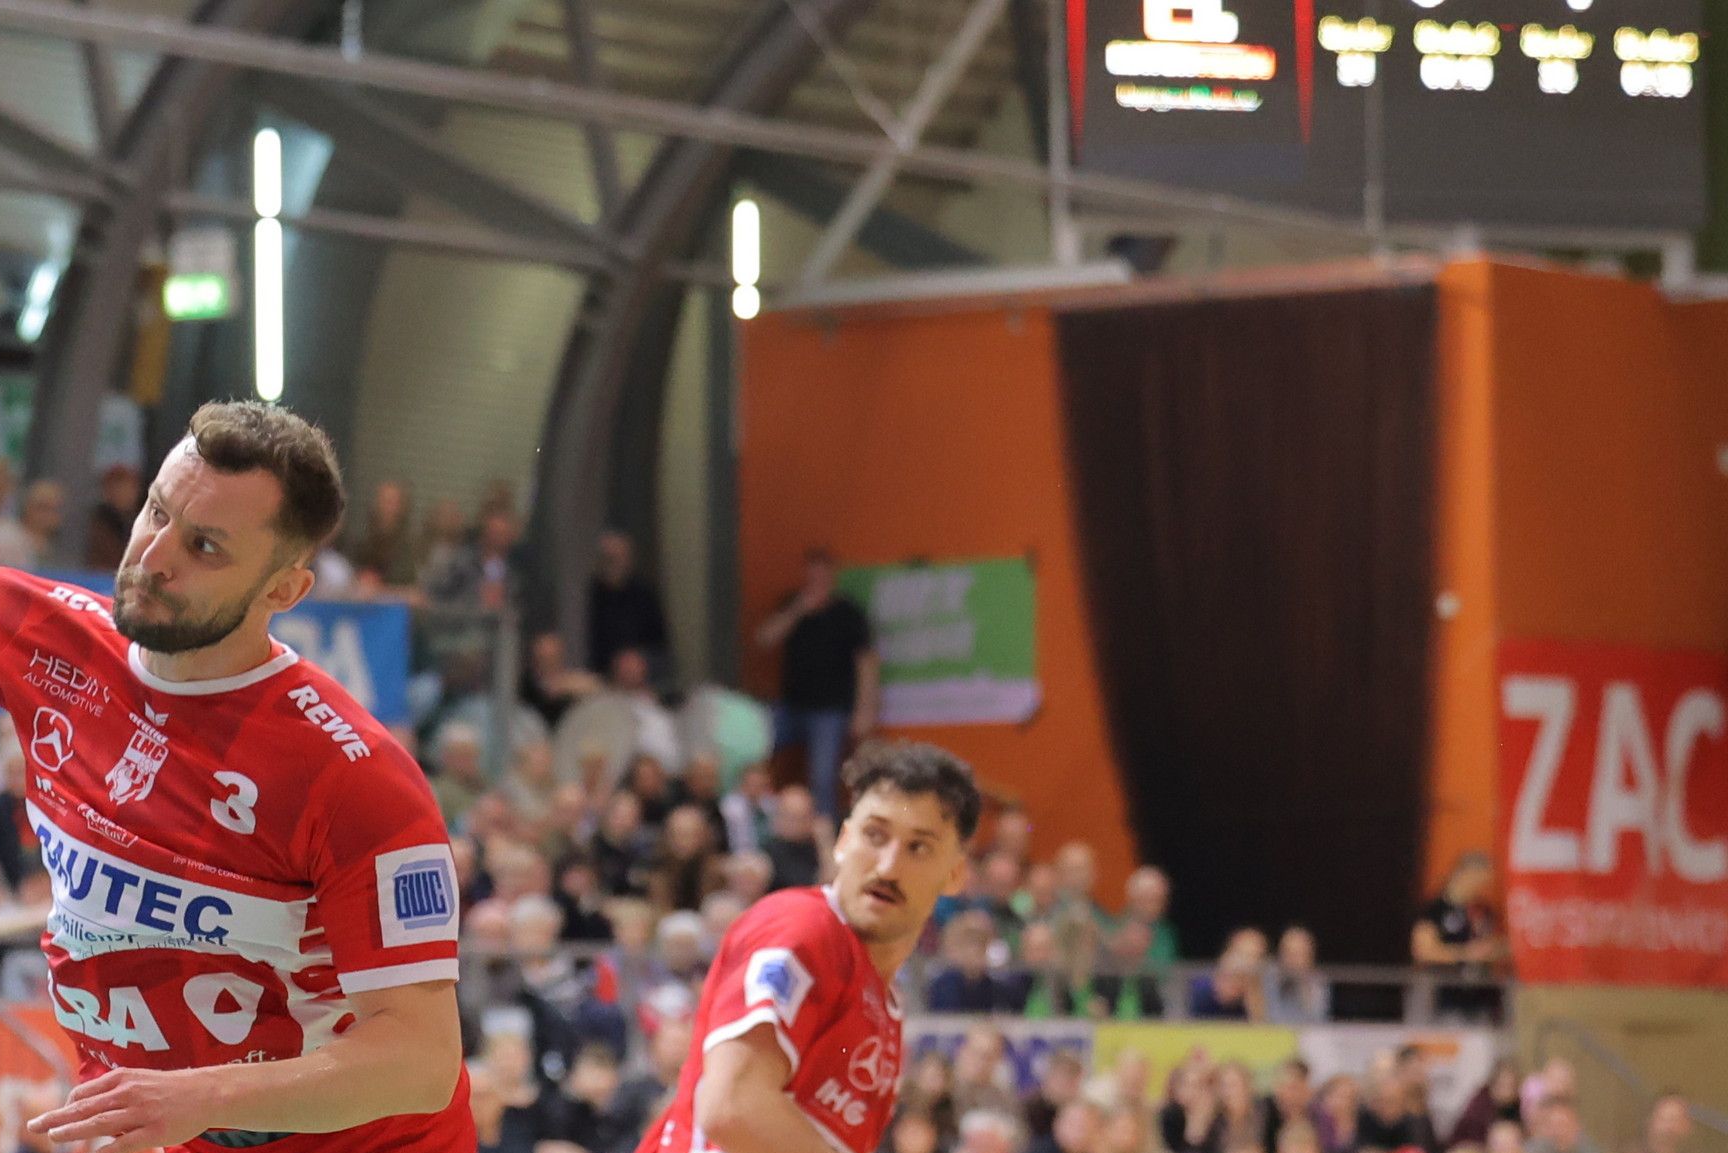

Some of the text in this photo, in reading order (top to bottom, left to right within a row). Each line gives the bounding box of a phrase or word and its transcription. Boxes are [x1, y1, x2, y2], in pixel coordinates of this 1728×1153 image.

[22, 671, 104, 718] AUTOMOTIVE
[287, 685, 371, 763] REWE
[210, 770, 259, 835] 3
